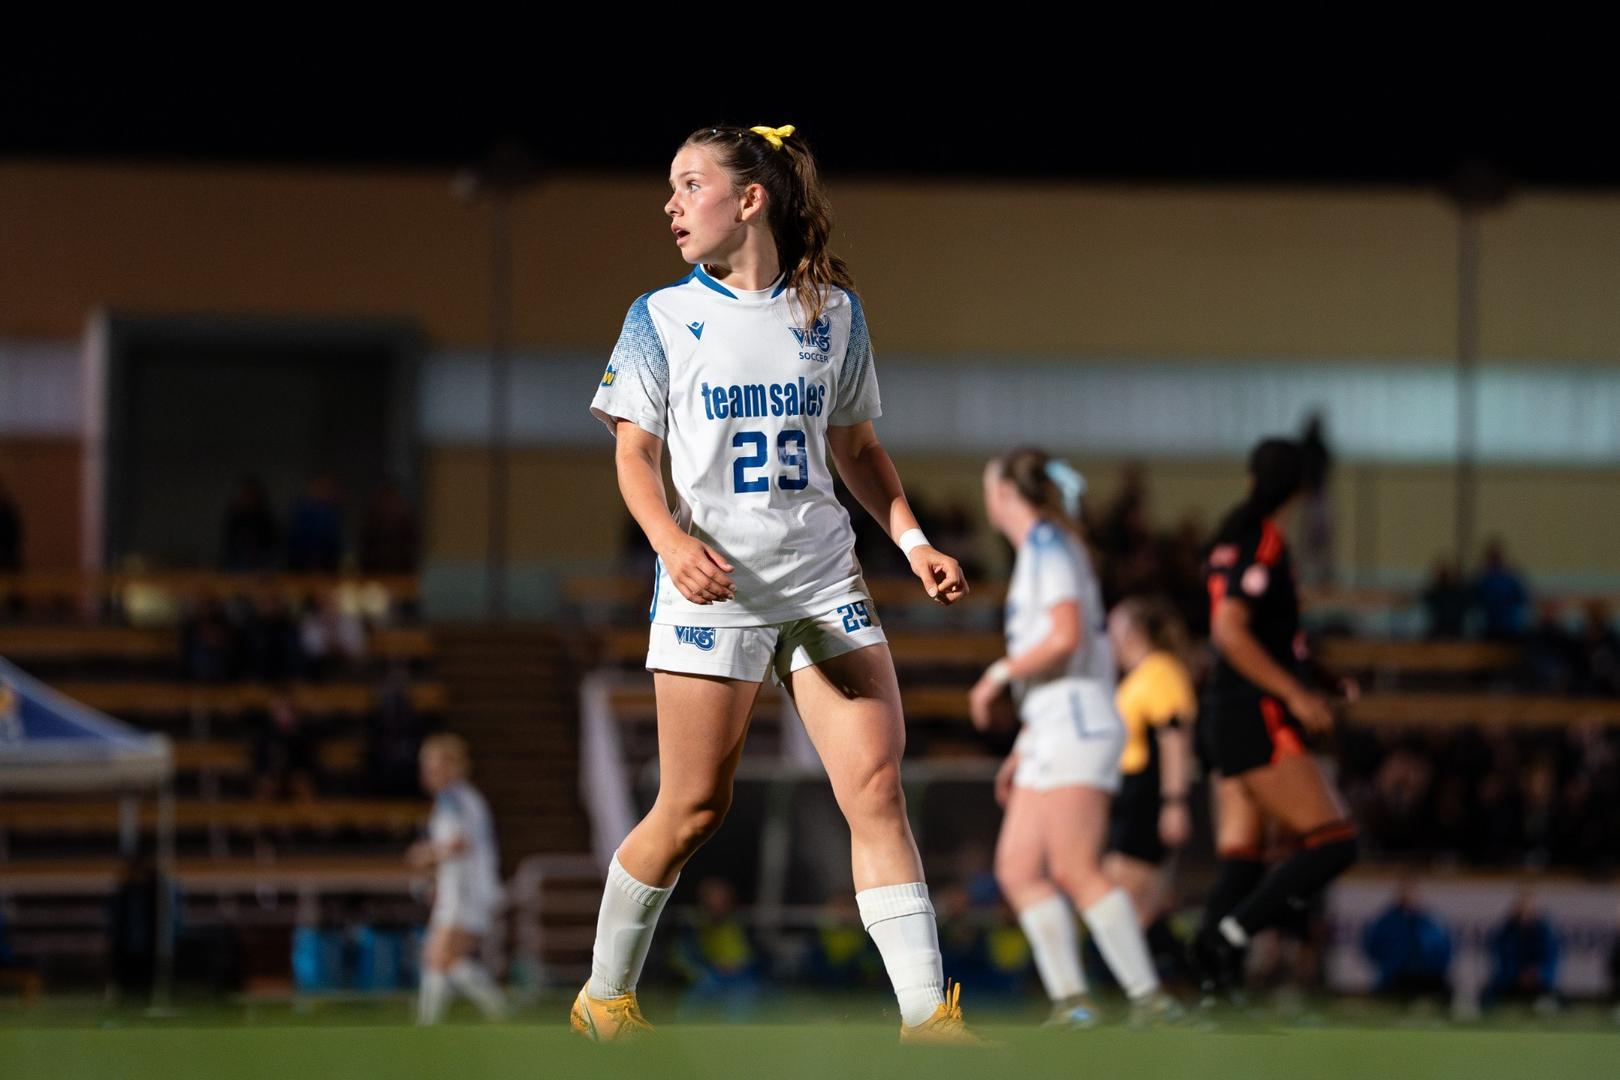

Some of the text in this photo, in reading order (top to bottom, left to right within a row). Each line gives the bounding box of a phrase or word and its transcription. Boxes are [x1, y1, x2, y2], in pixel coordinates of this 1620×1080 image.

[799, 351, 829, 363] SOCCER
[732, 429, 808, 494] 29
[836, 600, 872, 634] 29
